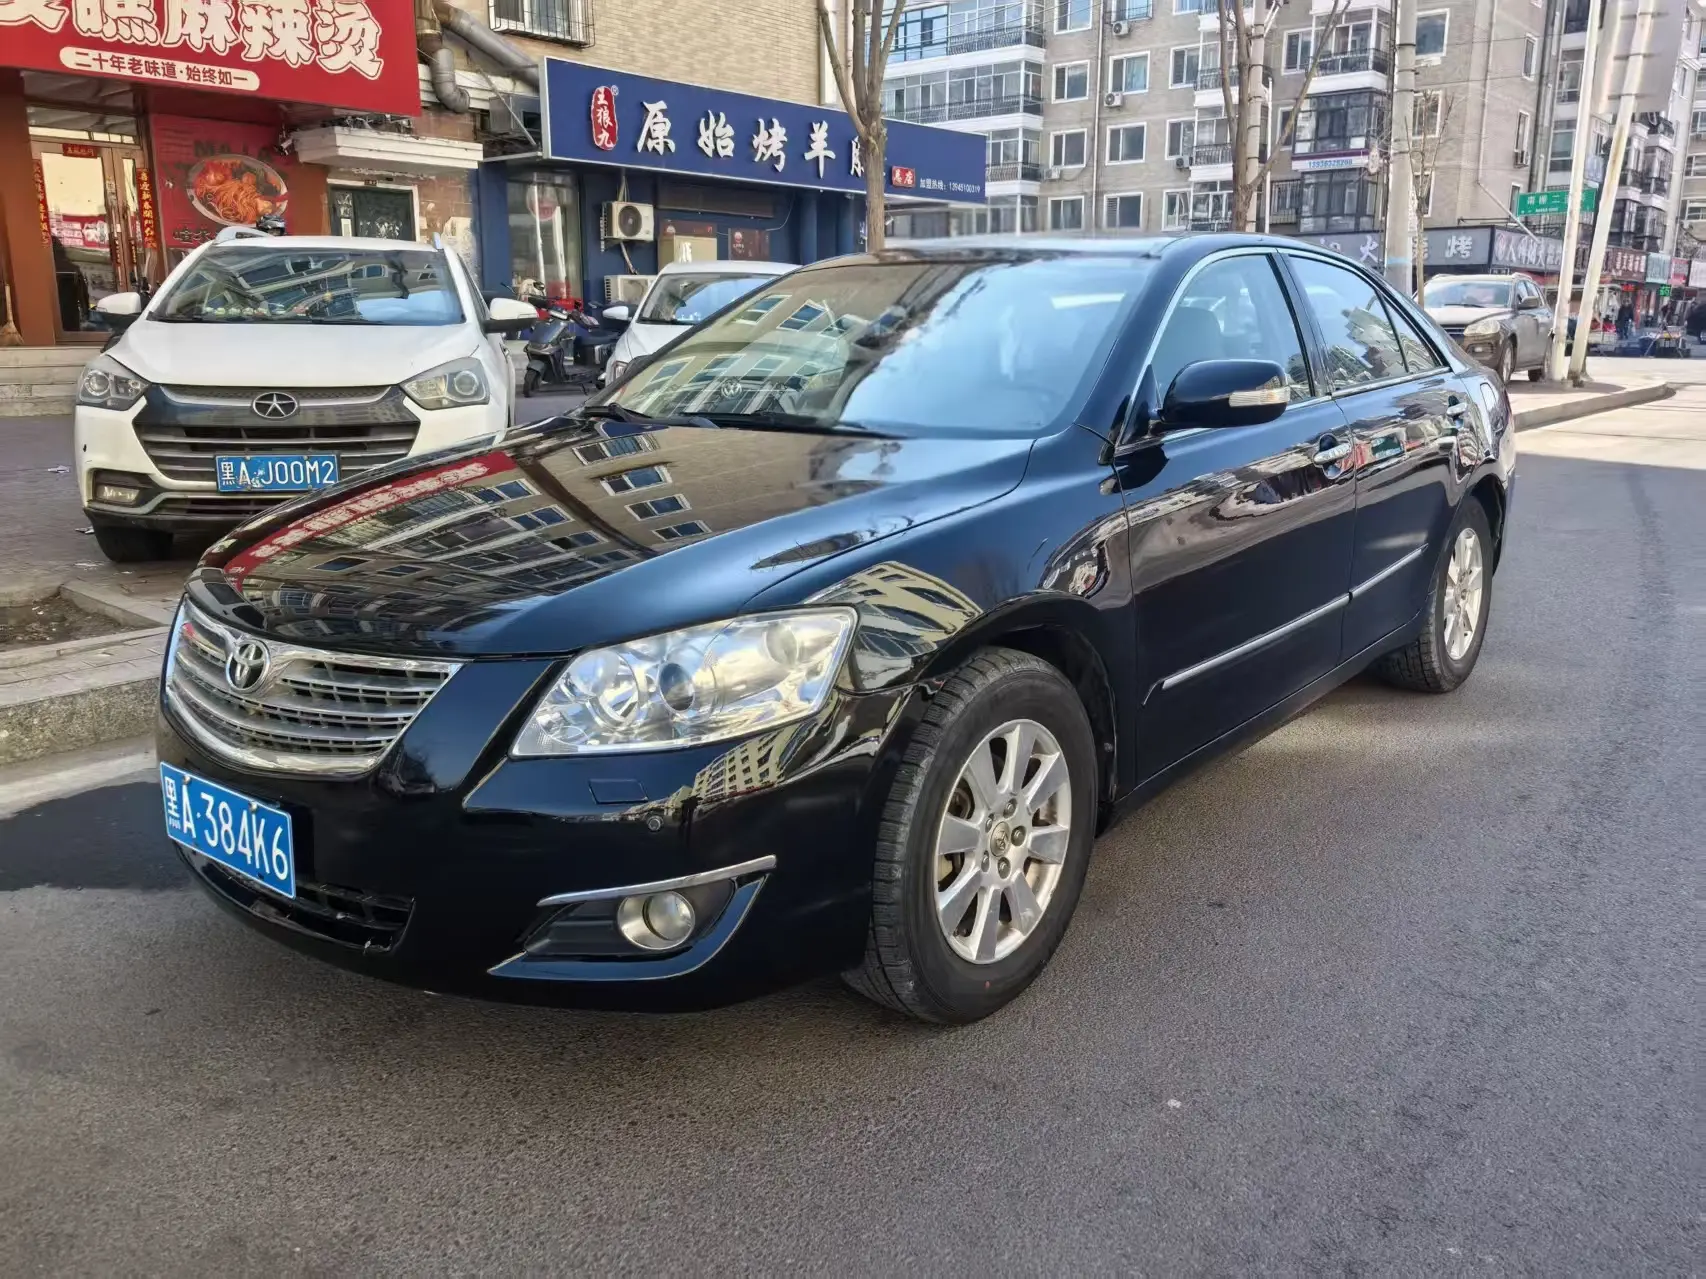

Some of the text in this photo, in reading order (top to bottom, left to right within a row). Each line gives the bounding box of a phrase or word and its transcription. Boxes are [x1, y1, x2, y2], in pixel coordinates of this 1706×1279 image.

[75, 51, 248, 86] 二十年老味道·始终如一
